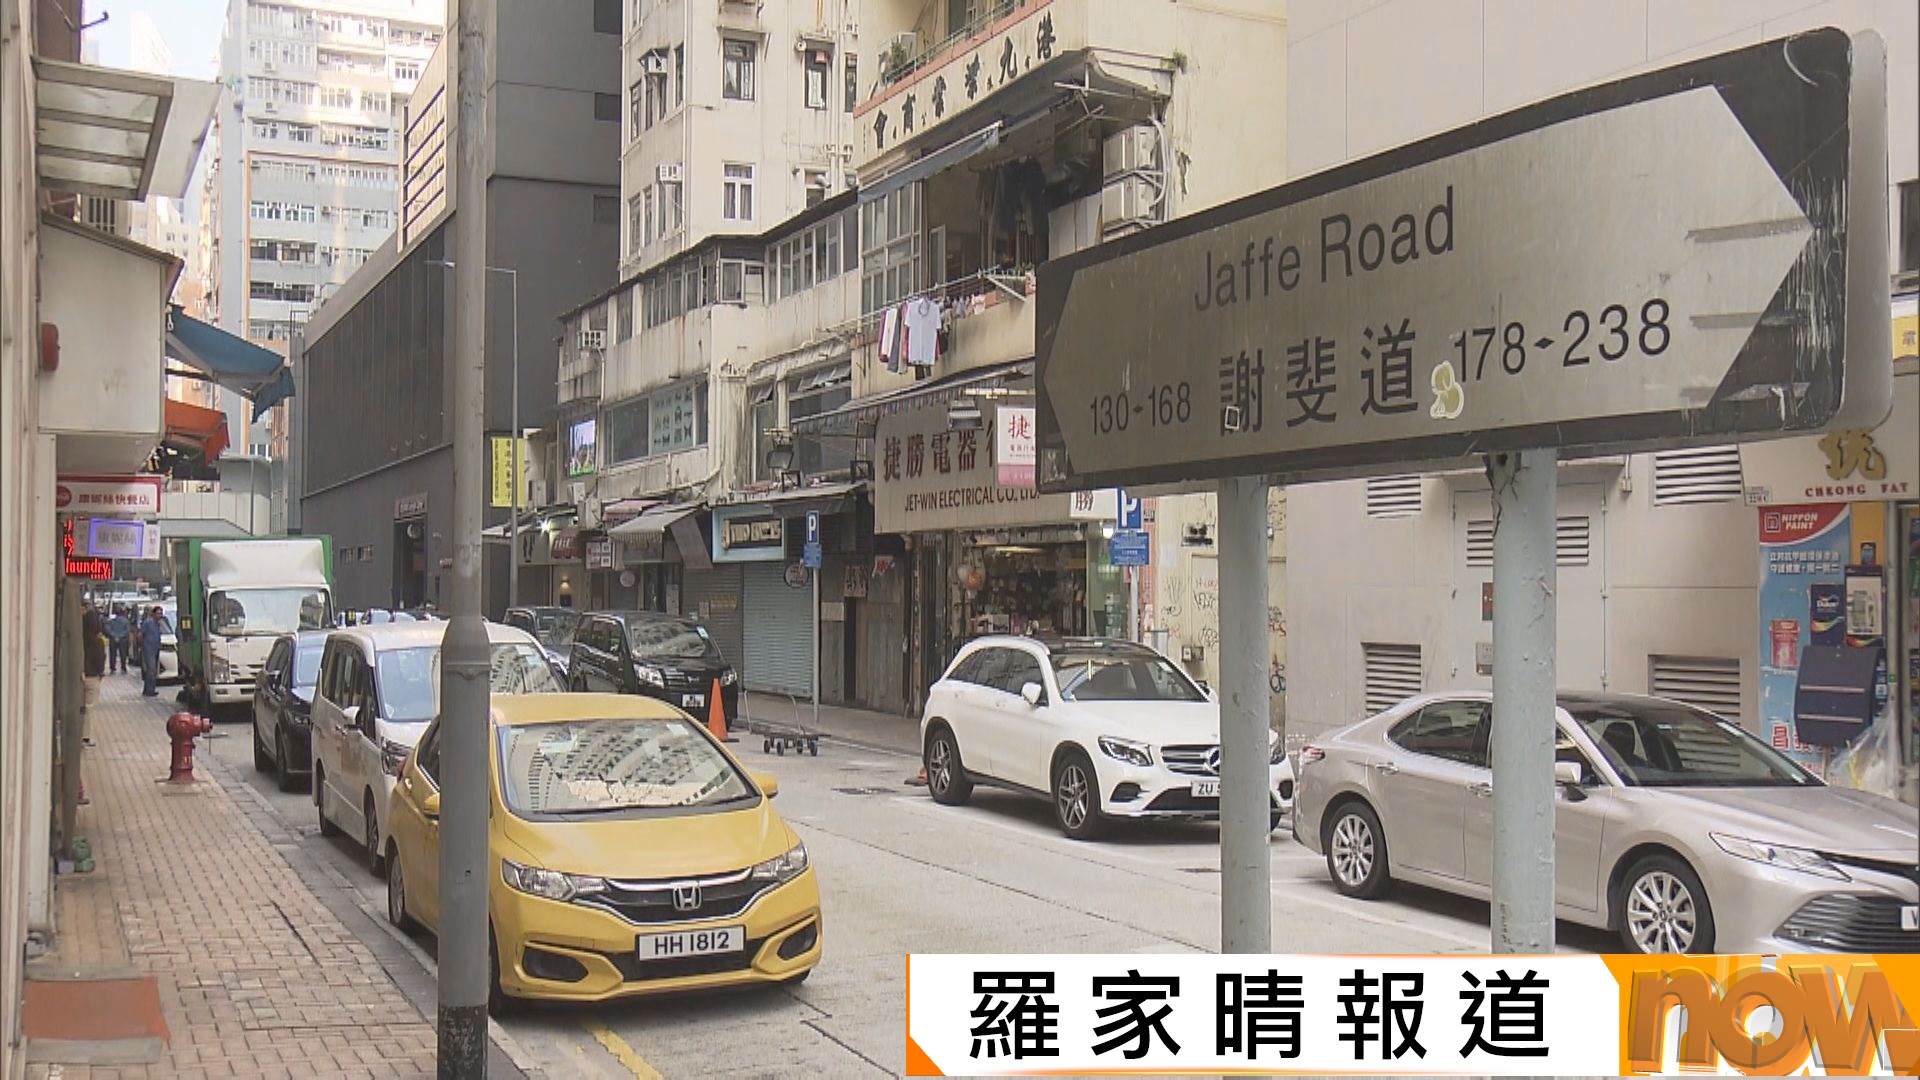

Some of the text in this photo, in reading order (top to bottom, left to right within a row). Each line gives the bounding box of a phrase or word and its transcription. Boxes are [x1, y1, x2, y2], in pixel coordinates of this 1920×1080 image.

[1194, 185, 1455, 312] Jaffe Road
[1090, 298, 1672, 437] 130-168 謝斐道 178-238
[1008, 413, 1032, 439] 捷
[939, 486, 995, 508] ELECTRICAL
[1805, 482, 1909, 497] CHEONG FAT
[808, 515, 817, 542] P
[1781, 512, 1819, 523] NIPPON
[1785, 521, 1815, 531] PAINT
[1198, 784, 1213, 795] ZU
[655, 931, 730, 955] HH 1812
